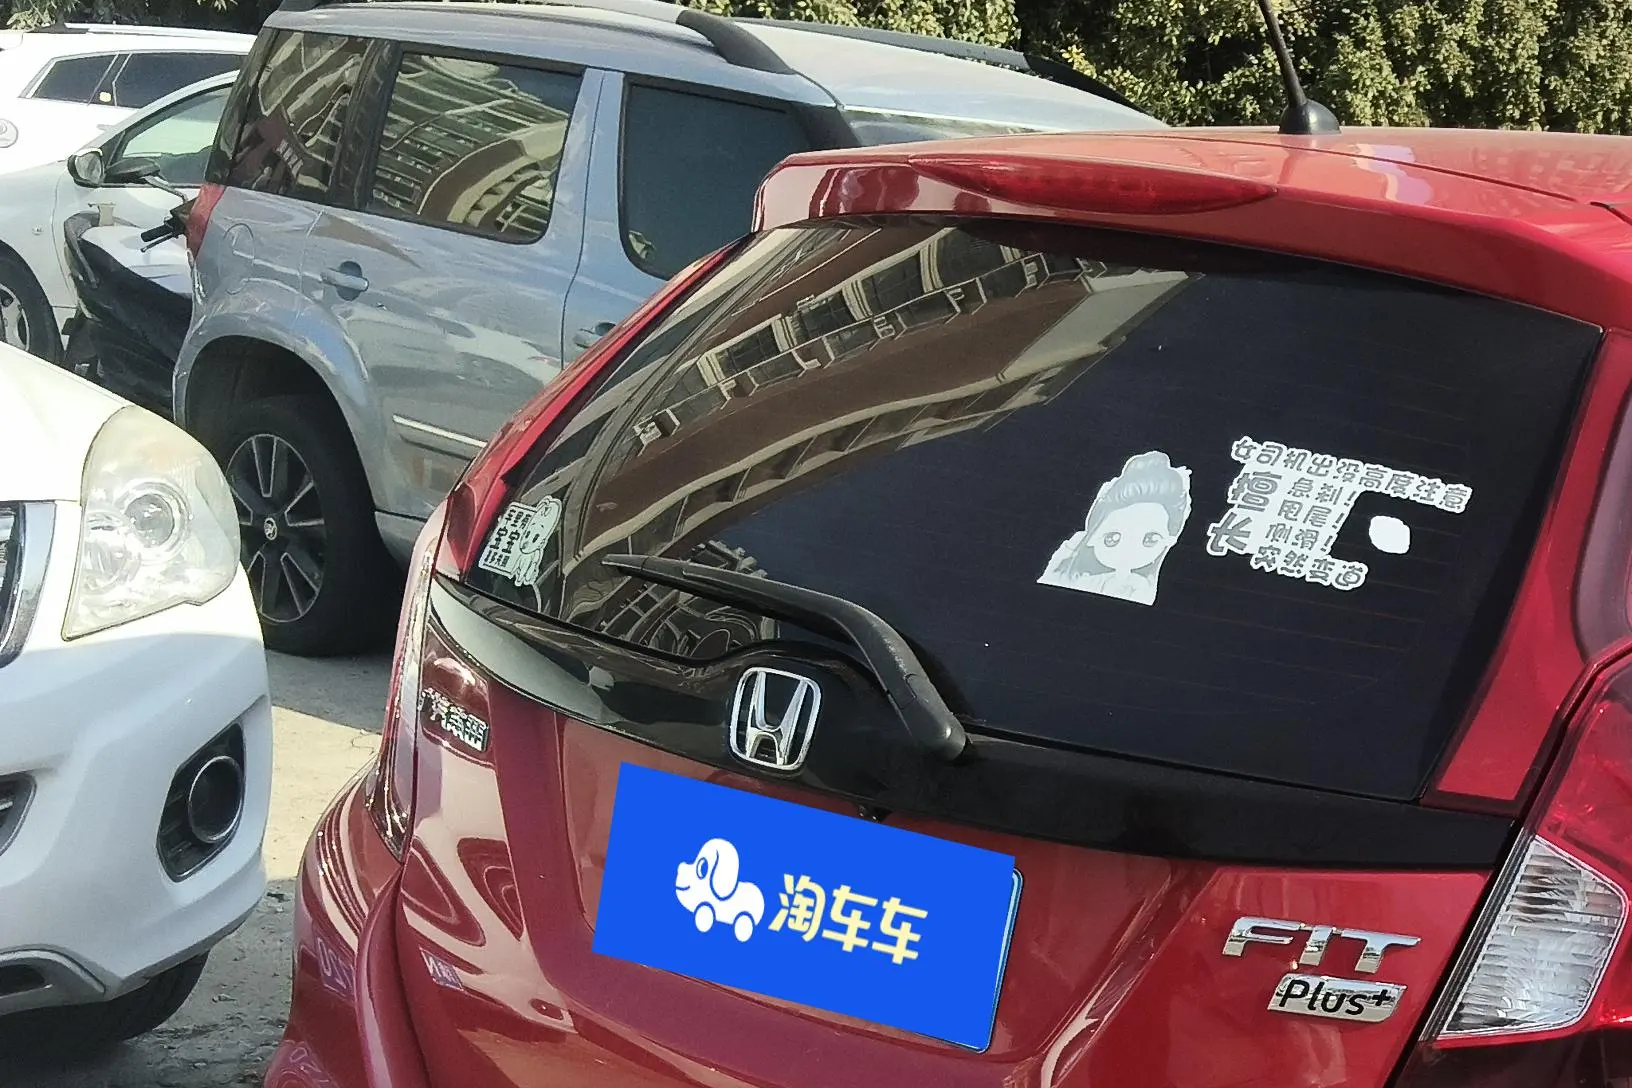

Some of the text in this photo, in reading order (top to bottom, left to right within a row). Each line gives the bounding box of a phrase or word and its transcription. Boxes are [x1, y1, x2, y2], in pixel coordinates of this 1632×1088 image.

[1235, 438, 1469, 510] 女司机出没高度注意
[1211, 471, 1282, 553] 擅长
[1253, 544, 1364, 586] 突然变道
[1221, 915, 1422, 974] FIT
